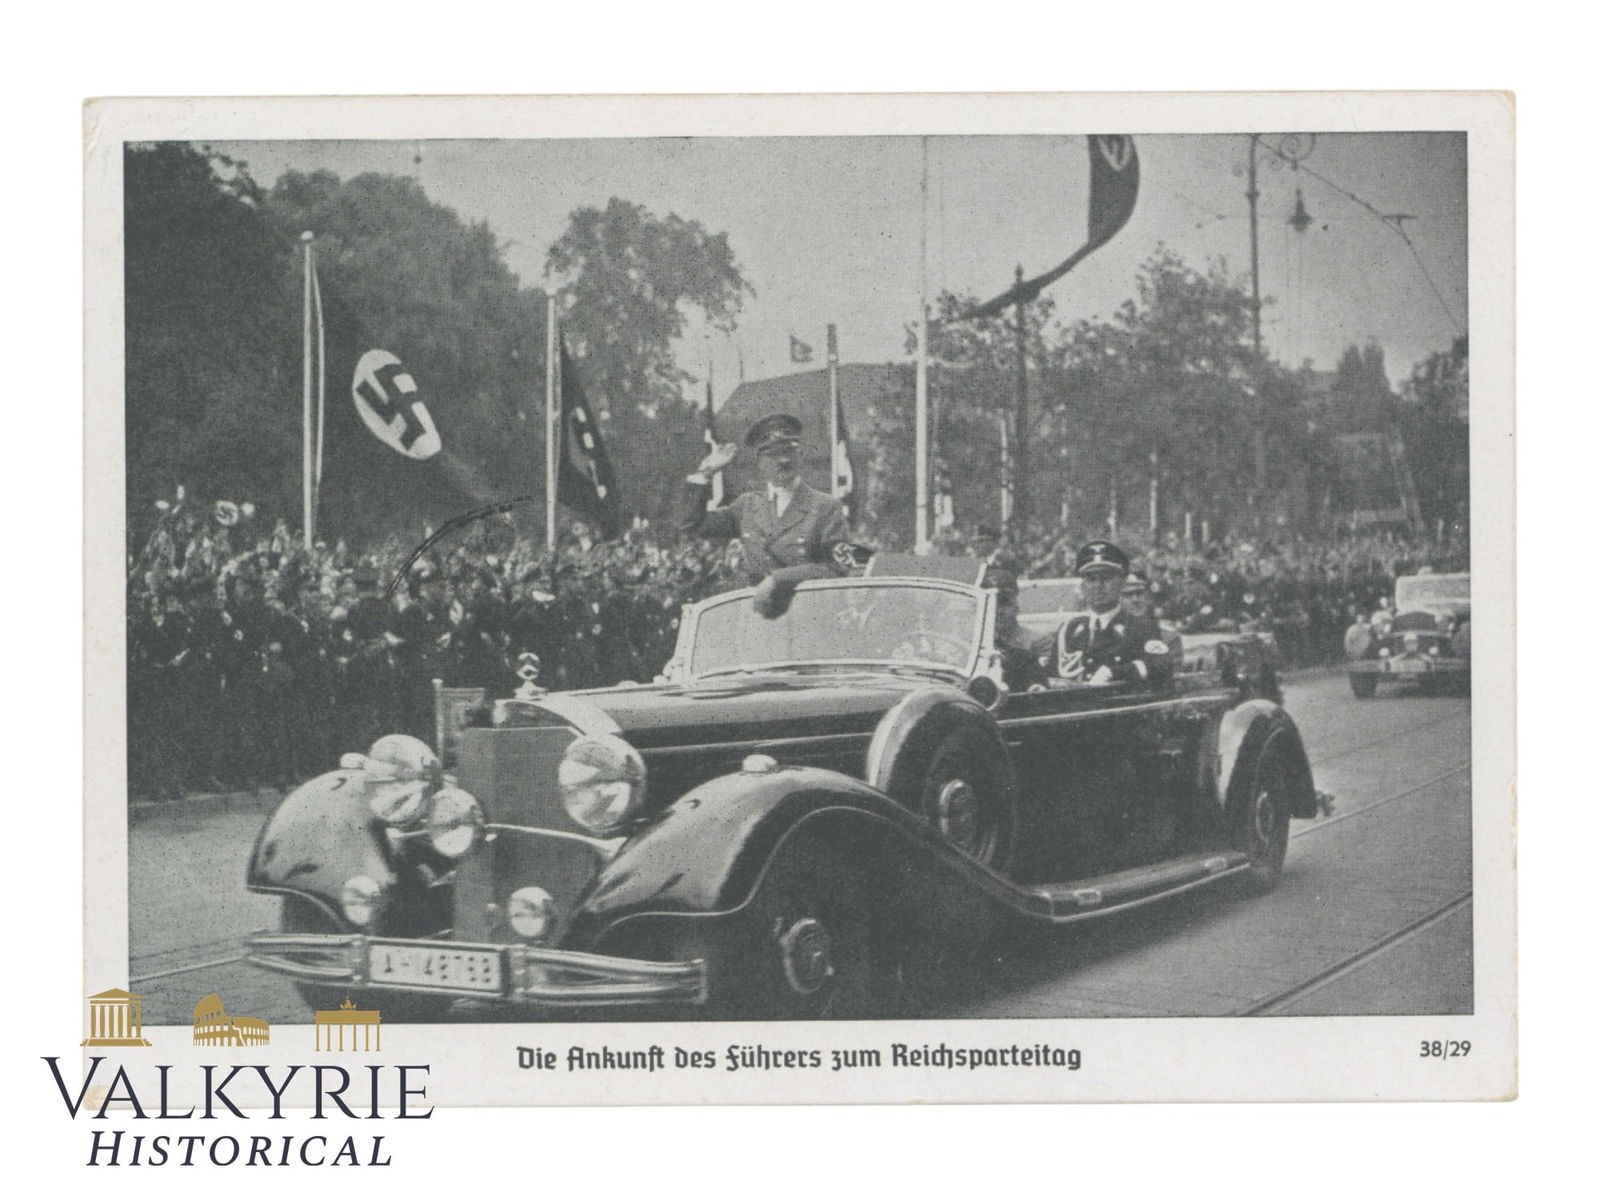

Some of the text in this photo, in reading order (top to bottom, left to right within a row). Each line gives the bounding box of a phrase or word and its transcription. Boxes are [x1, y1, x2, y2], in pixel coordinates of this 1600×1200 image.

[516, 1042, 1082, 1073] Die Ankunft des Führers zum Reichsparteitag
[1419, 1040, 1472, 1060] 38/29
